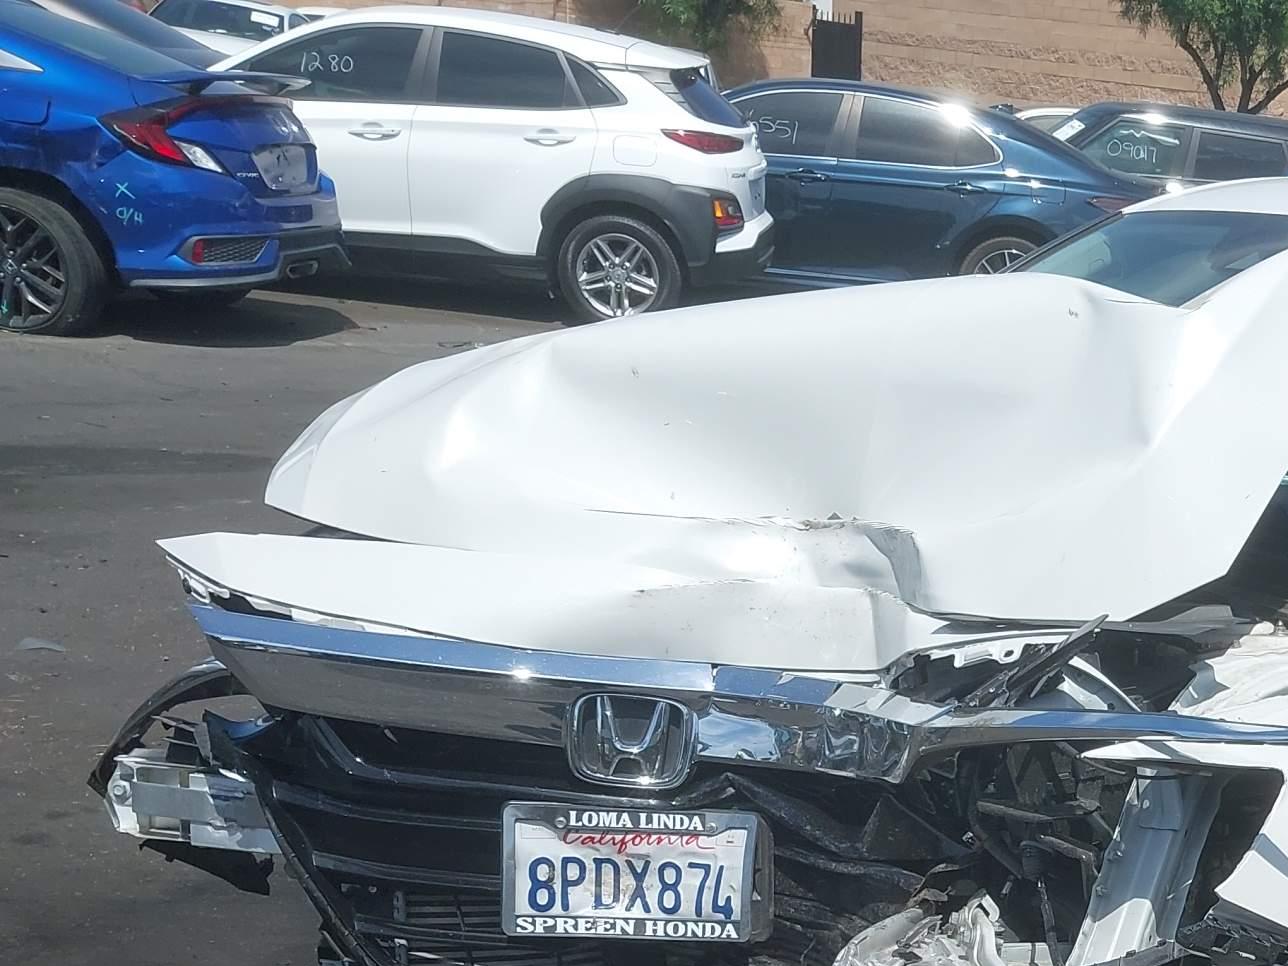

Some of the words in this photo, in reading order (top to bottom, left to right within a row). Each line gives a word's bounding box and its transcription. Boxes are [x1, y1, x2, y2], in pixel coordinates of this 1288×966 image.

[300, 51, 354, 73] 1280
[568, 810, 634, 828] LOMA
[638, 812, 704, 831] LINDA
[562, 829, 716, 855] California
[527, 856, 734, 920] 8PDX874
[516, 916, 636, 935] SPREEN
[644, 920, 739, 938] HONDA
